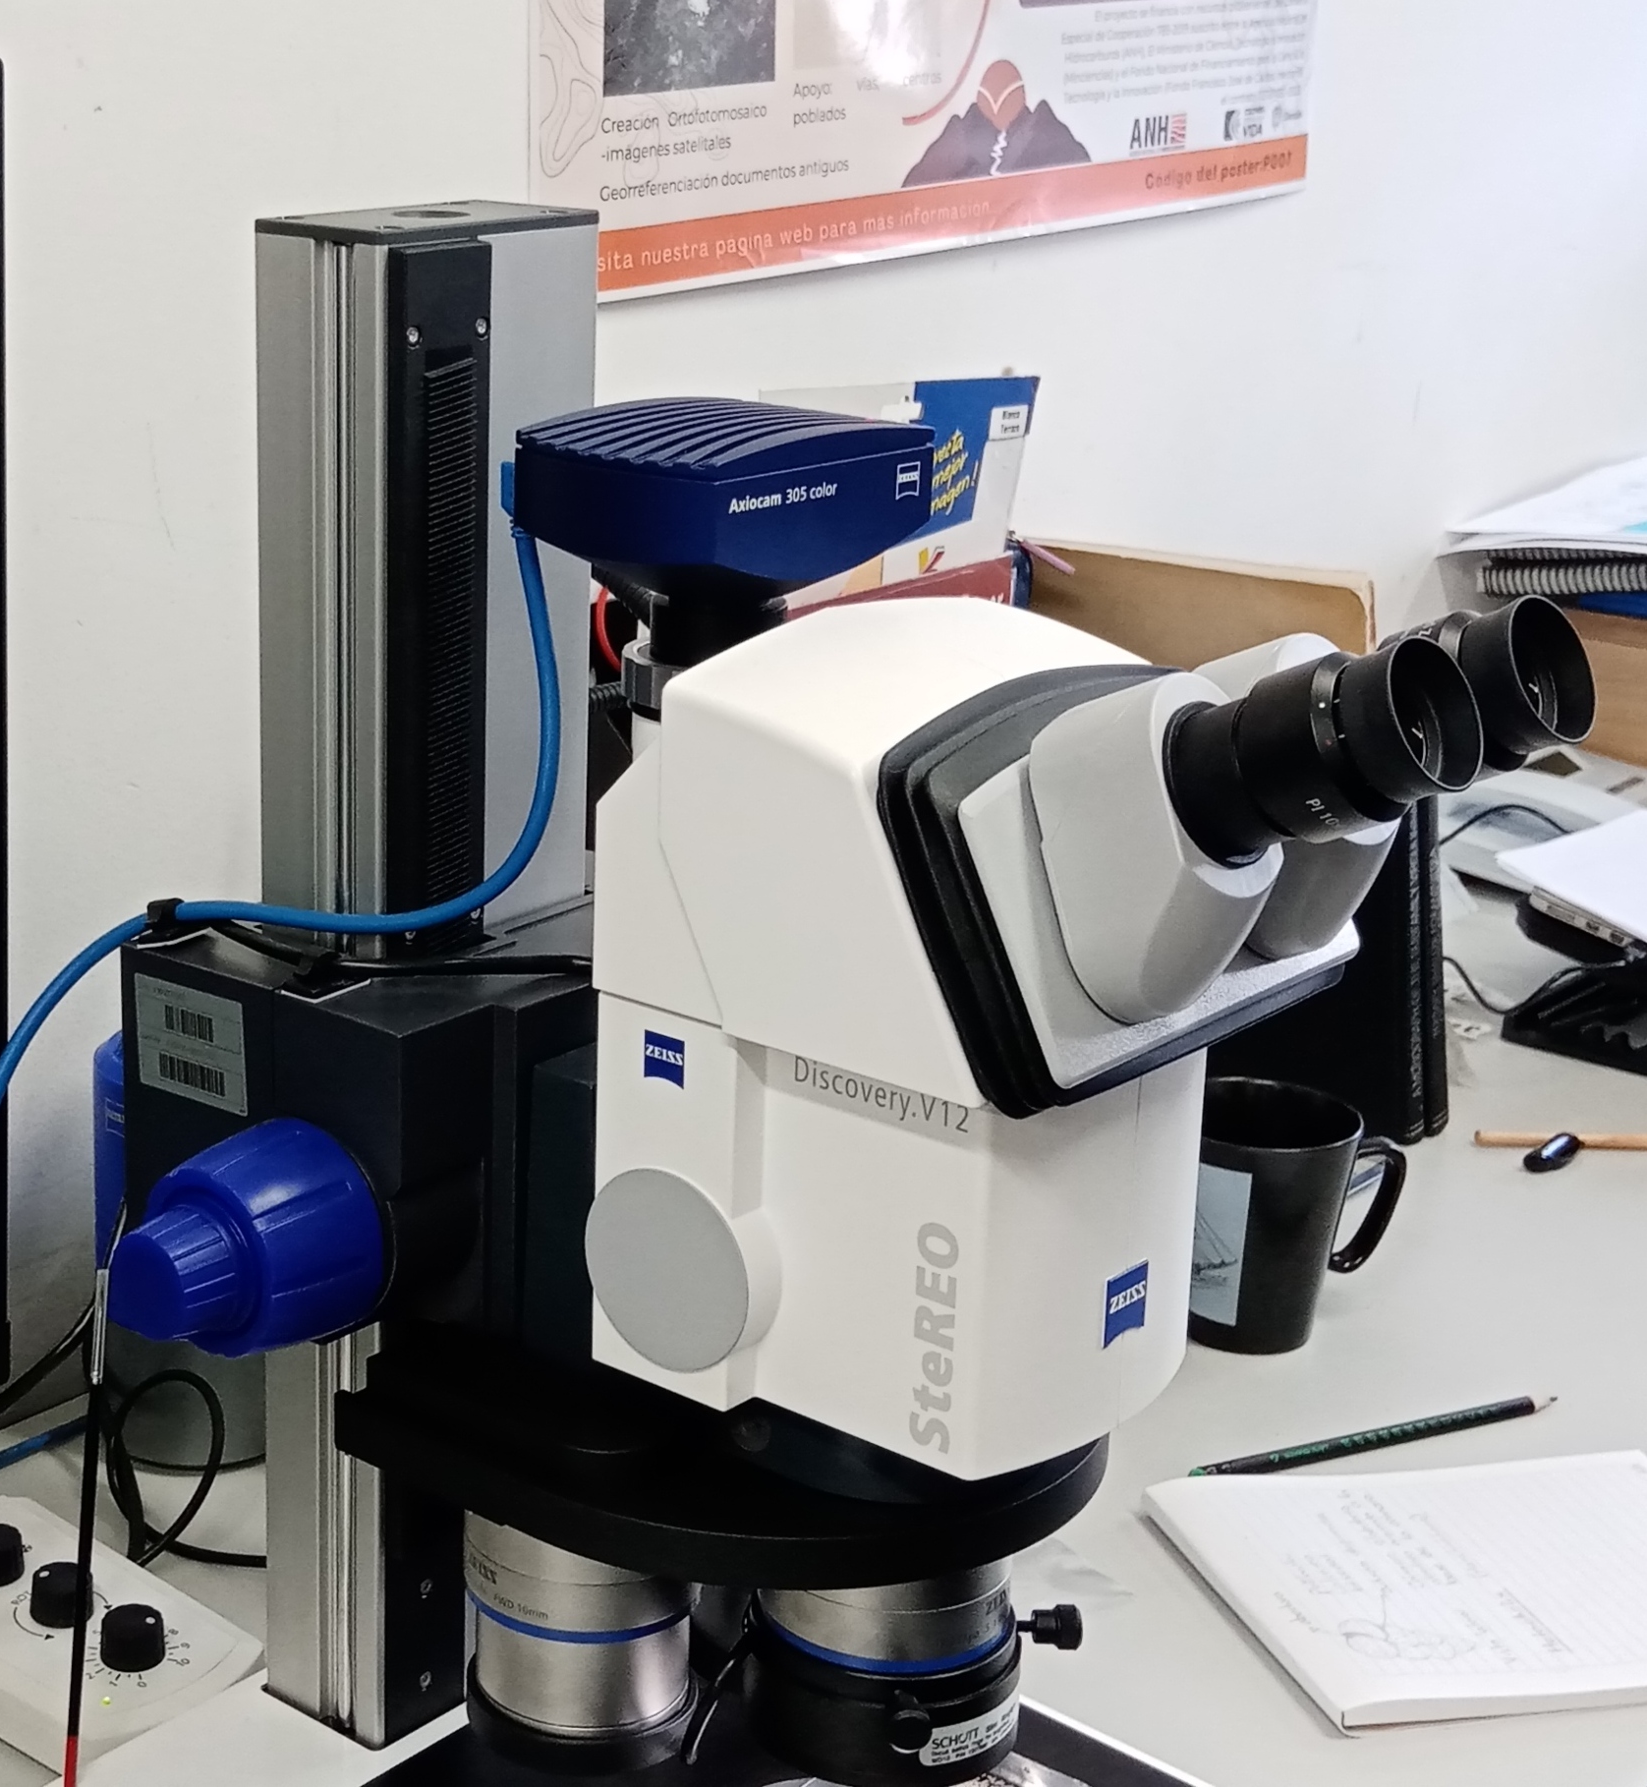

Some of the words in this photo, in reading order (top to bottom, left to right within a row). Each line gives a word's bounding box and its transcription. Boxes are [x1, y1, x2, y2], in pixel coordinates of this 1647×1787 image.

[668, 104, 768, 128] Ortofotomosaico
[793, 107, 846, 128] poblados
[673, 134, 732, 156] satelitales
[1130, 115, 1170, 150] ANH
[721, 165, 796, 188] documentos
[799, 158, 849, 178] antiguos
[597, 251, 634, 272] sita
[641, 242, 709, 266] nuestra
[780, 224, 813, 246] web
[819, 220, 856, 242] para
[728, 494, 782, 514] Axiocam
[785, 485, 808, 504] 305
[809, 481, 838, 500] color
[646, 1044, 683, 1067] ZEISS
[794, 1054, 969, 1134] Discovery.V12
[1109, 1280, 1146, 1314] ZEISS
[909, 1222, 959, 1454] SteREO
[932, 1727, 980, 1750] SCHOTT
